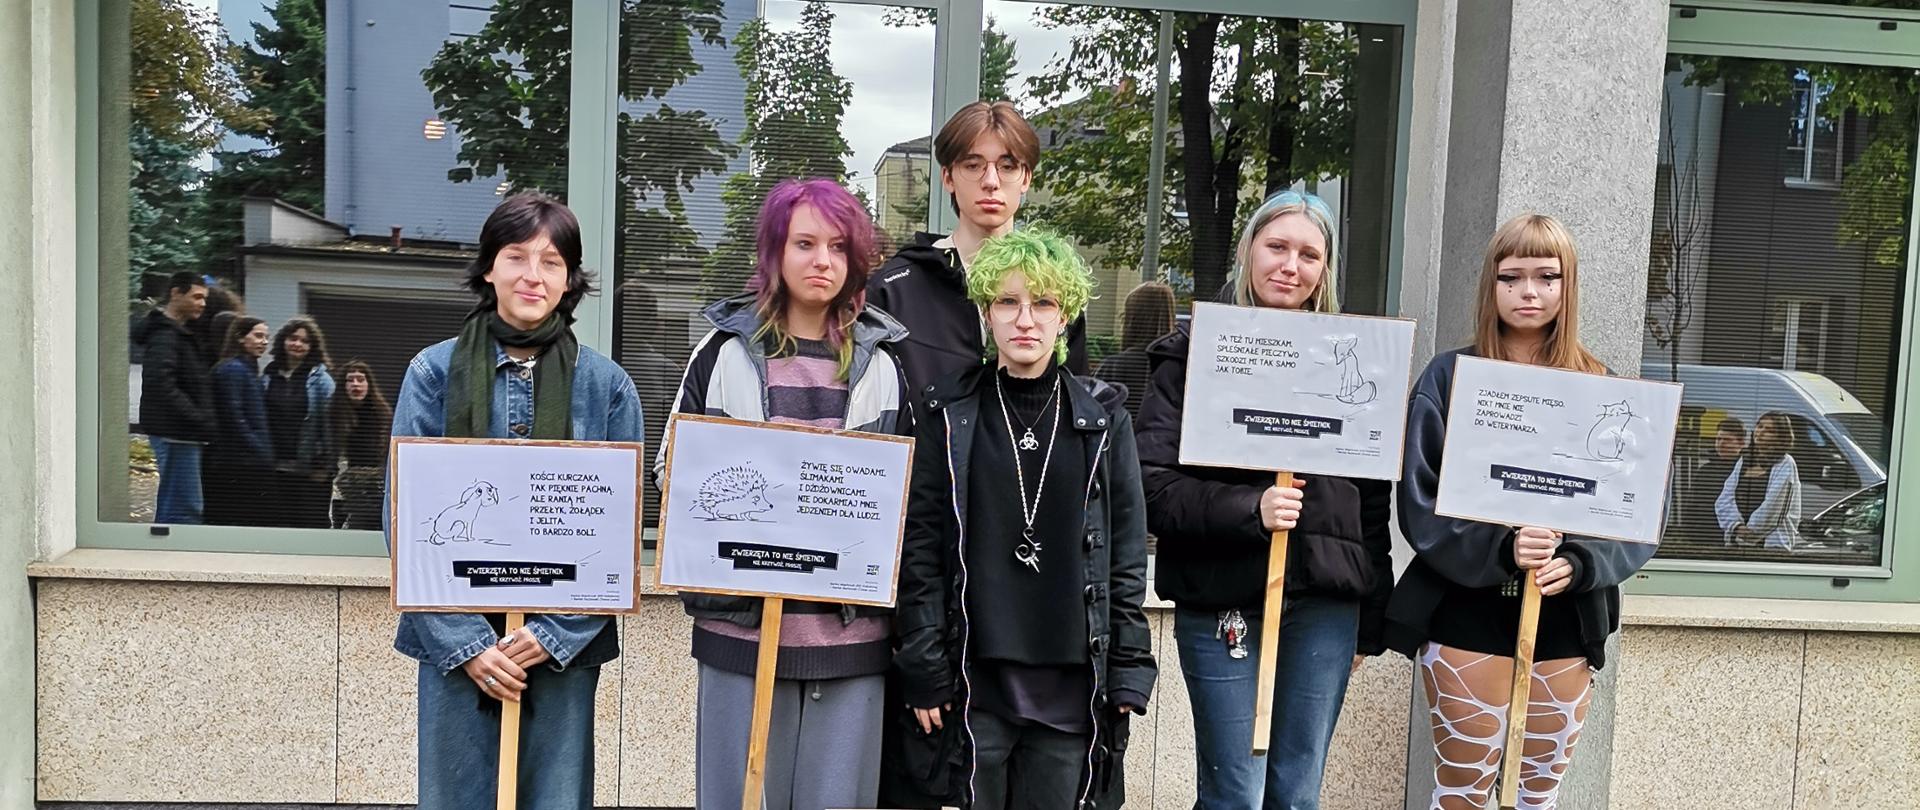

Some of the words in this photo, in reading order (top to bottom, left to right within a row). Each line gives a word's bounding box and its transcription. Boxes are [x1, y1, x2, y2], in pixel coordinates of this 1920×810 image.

[1230, 334, 1242, 343] TEŻ
[1262, 349, 1299, 358] PIECZYWO
[1217, 355, 1246, 364] SZKODZI
[1479, 389, 1509, 399] ZJADŁEM
[1512, 394, 1539, 404] ZEPSUTE
[1495, 402, 1510, 410] MNIE
[1477, 409, 1522, 421] ZAPROWADZI
[1245, 415, 1280, 425] ZWIERZĘTA
[1291, 418, 1301, 426] NIE
[1303, 418, 1331, 429] ŚMIETNIK
[801, 460, 827, 473] ŻYWIĘ
[830, 464, 843, 475] SIĘ
[530, 472, 555, 480] KOŚCI
[800, 471, 844, 483] ŚLIMAKAMI
[1501, 471, 1535, 482] ZWIERZĘTA
[1558, 478, 1585, 488] ŚMIETNIK
[549, 485, 578, 494] PIĘKNIE
[548, 496, 573, 505] RANIĄ
[813, 496, 857, 507] DOKARMIAJ
[797, 506, 837, 516] JEDZENIEM
[840, 510, 854, 518] DLA
[731, 549, 769, 560] ZWIERZĘTA
[795, 552, 826, 563] ŚMIETNIK
[467, 567, 506, 576] ZWIERZĘTA
[533, 566, 563, 575] ŚMIETNIK
